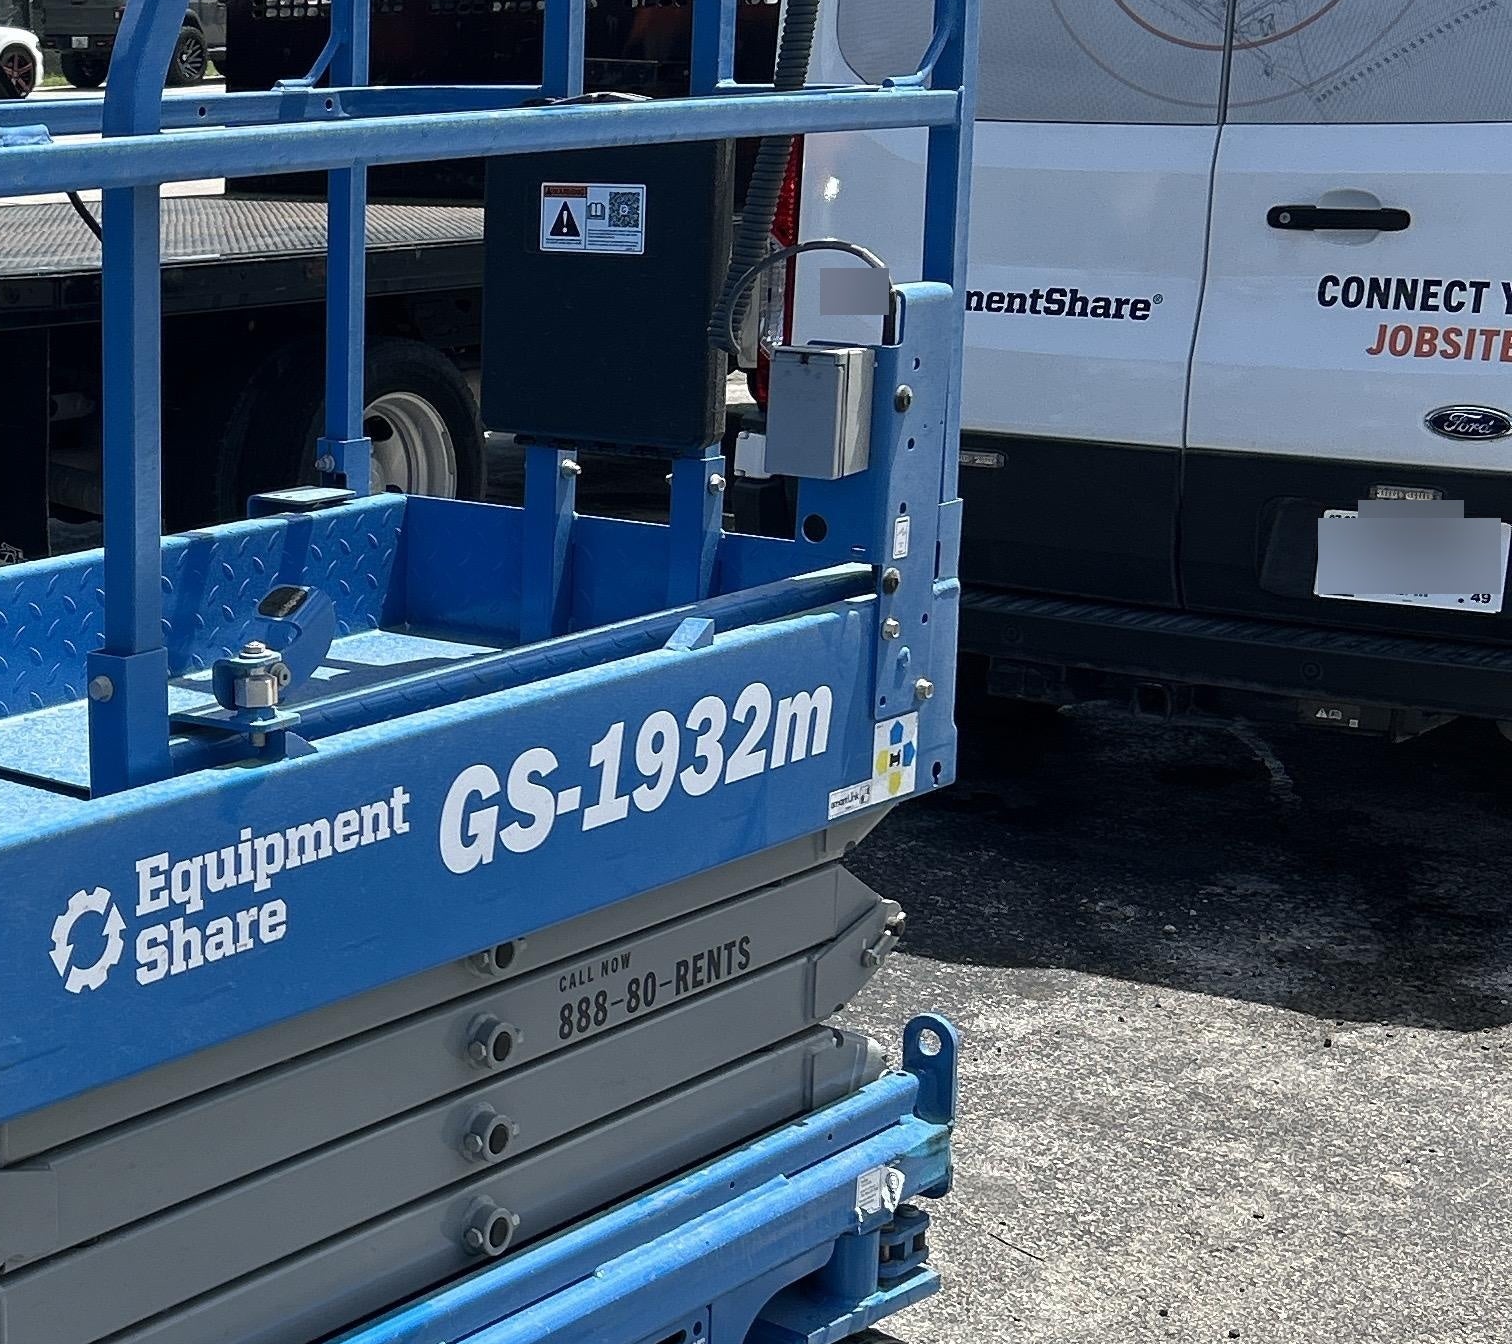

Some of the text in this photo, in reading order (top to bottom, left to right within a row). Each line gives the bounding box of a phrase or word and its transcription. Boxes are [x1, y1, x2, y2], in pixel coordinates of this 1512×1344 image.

[1317, 274, 1491, 314] CONNECT
[1443, 412, 1494, 434] Ford
[439, 681, 832, 874] GS-1932m
[133, 786, 411, 917] Equipment
[133, 897, 288, 987] Share
[559, 952, 632, 993] CALL NOW
[558, 935, 751, 1040] 888-80-RENTS
